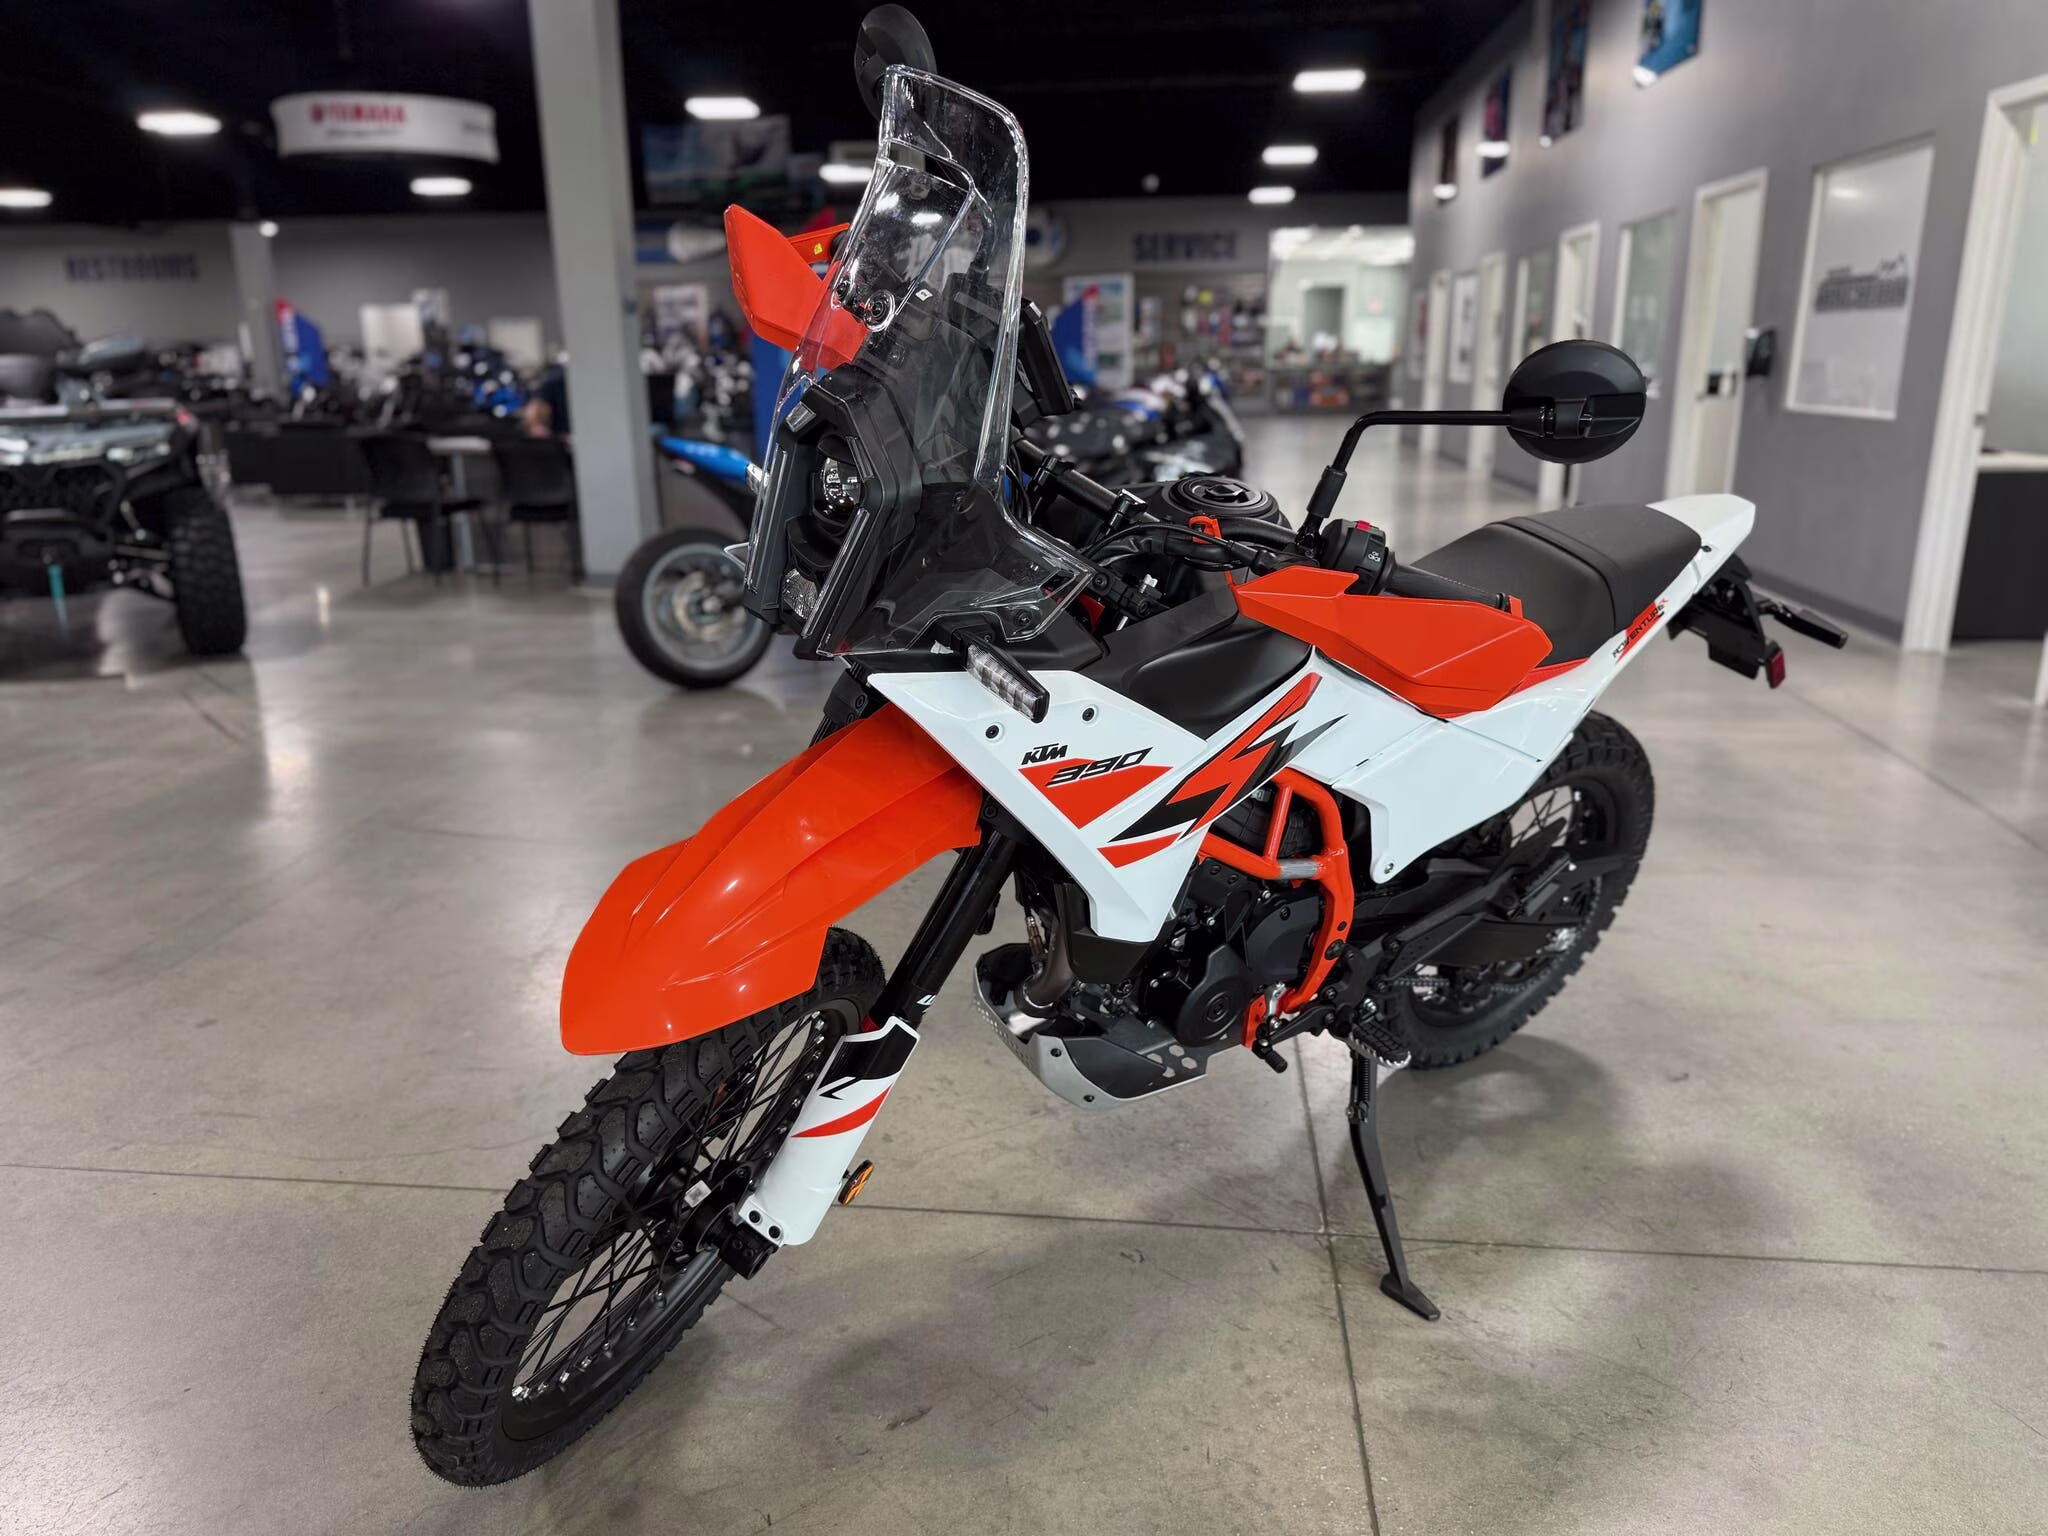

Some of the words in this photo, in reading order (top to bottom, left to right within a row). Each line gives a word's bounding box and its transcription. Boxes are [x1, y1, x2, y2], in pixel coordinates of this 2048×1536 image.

[1133, 231, 1238, 262] SERVICE
[1612, 604, 1665, 658] ADVENTURE
[1021, 743, 1068, 765] KTM
[1045, 746, 1153, 787] 390
